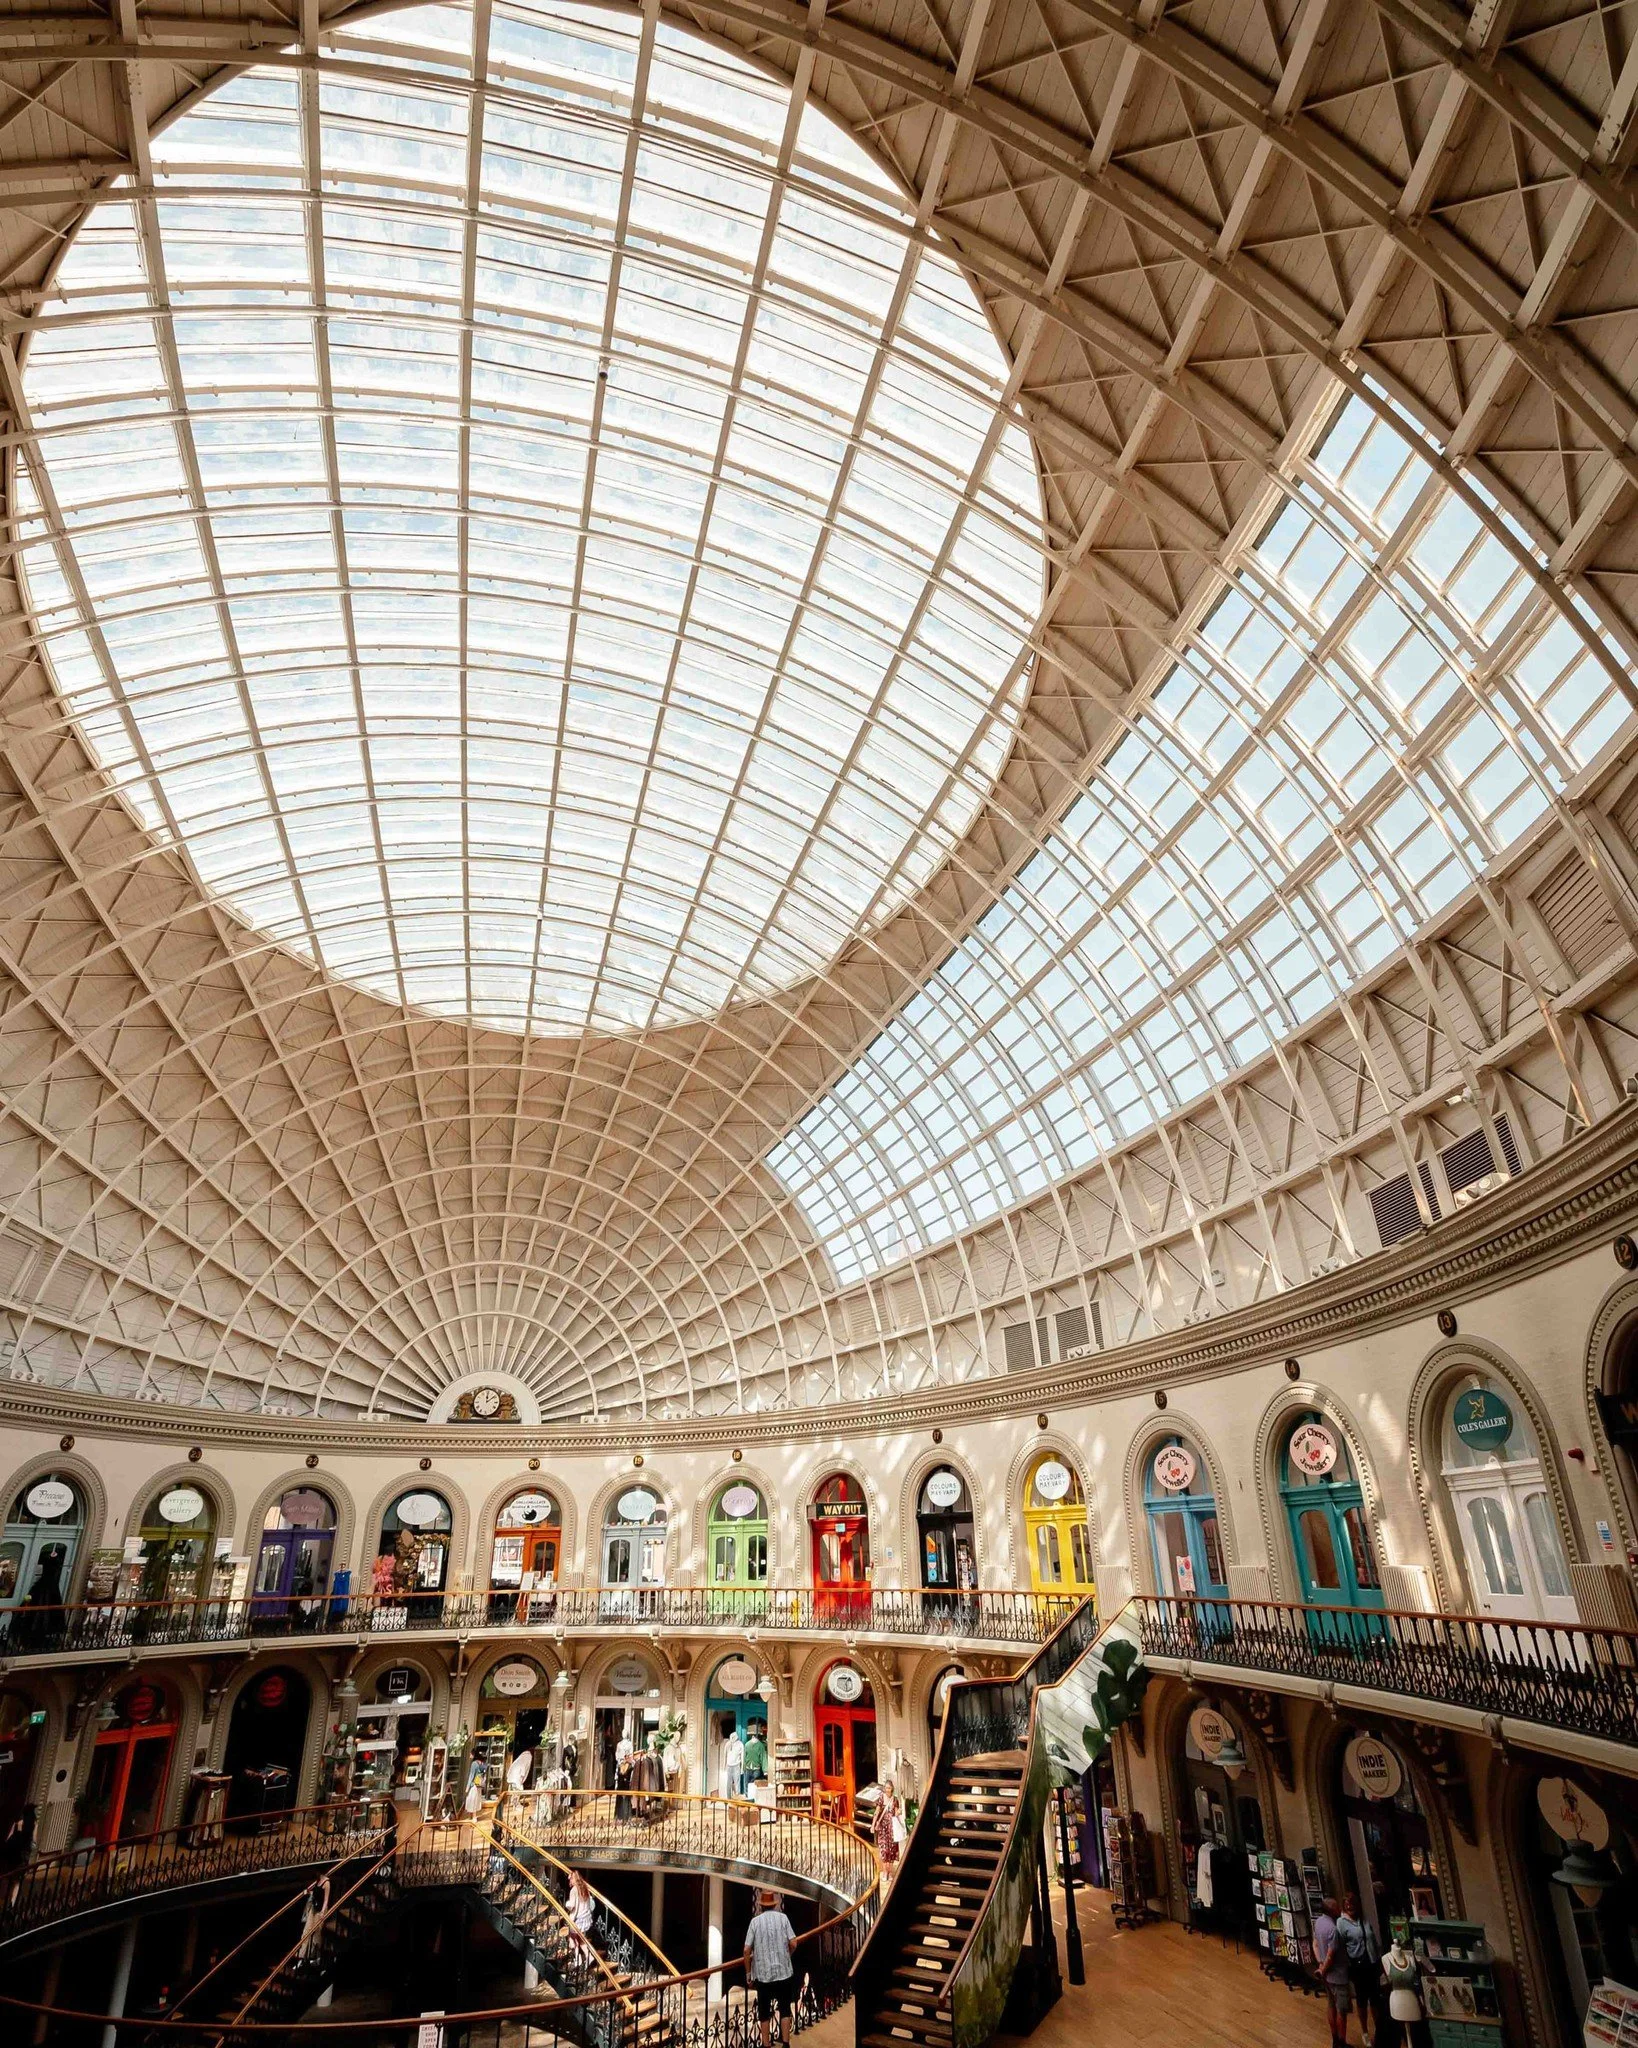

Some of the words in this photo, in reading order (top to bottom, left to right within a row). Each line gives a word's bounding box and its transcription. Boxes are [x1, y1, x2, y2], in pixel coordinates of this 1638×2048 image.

[1616, 1244, 1631, 1262] 12
[1439, 1315, 1452, 1330] 13
[1458, 1421, 1479, 1434] COLE'S
[1479, 1416, 1507, 1430] GALLERY
[1293, 1432, 1308, 1450] Sour
[1306, 1427, 1331, 1447] Cherry
[529, 1460, 540, 1468] 20
[1299, 1454, 1330, 1473] Jewellery
[1039, 1472, 1067, 1482] COLOURS
[930, 1482, 957, 1490] COLOURS
[165, 1497, 200, 1506] evergreen
[823, 1504, 843, 1516] WAY
[844, 1504, 862, 1515] OUT
[1202, 1723, 1221, 1735] INDIE
[1358, 1754, 1385, 1769] INDIE
[1362, 1769, 1388, 1778] MAKERS
[551, 1850, 567, 1858] OUR
[569, 1850, 588, 1859] PAST
[590, 1850, 620, 1860] SHAPES
[622, 1851, 637, 1861] OUR
[639, 1852, 665, 1863] FUTURE
